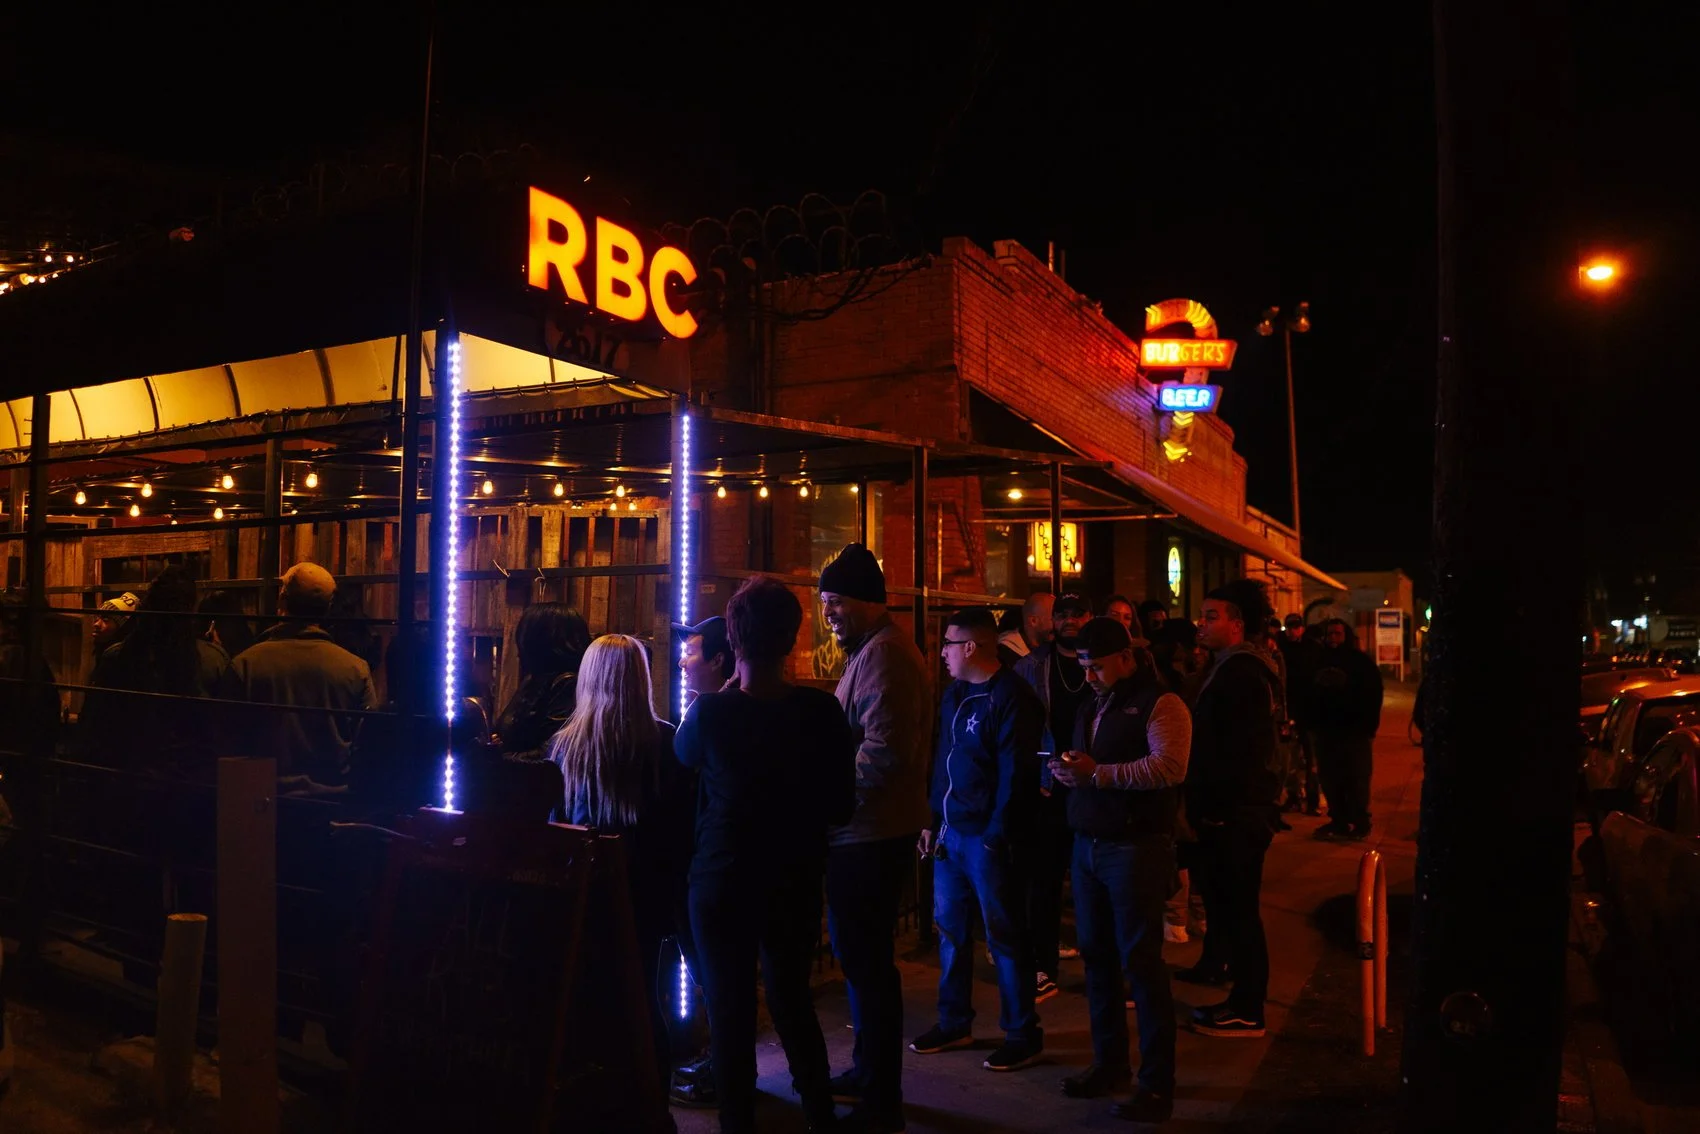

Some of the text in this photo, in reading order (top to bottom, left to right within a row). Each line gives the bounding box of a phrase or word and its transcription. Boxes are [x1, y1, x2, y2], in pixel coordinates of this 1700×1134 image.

[527, 185, 699, 340] RBC
[1144, 342, 1226, 363] BURGERS
[1162, 388, 1211, 407] BEER
